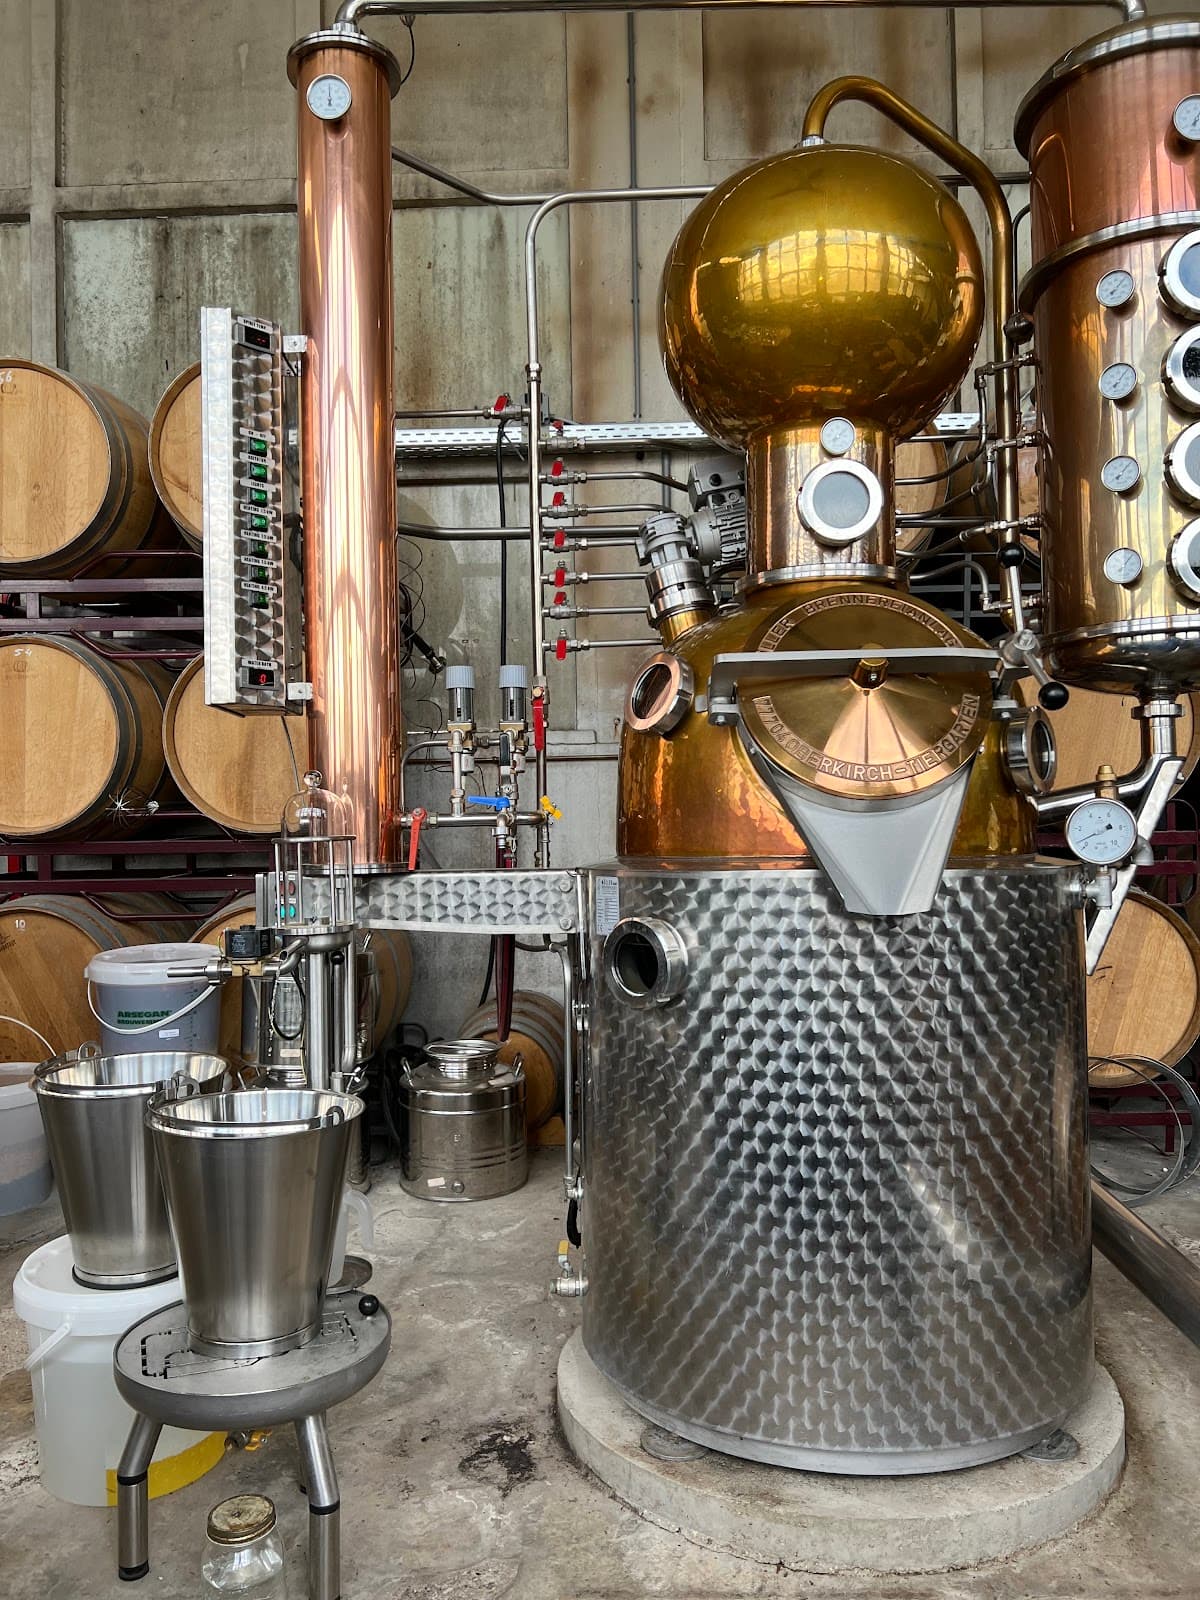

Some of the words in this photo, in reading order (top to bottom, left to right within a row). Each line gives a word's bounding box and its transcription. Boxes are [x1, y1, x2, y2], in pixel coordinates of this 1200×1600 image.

[758, 618, 796, 651] LLER
[803, 593, 963, 648] BRENNEREIANLAG
[754, 697, 789, 743] 77704
[784, 694, 979, 781] OBERKIRCH-TIERGARTEN
[15, 919, 26, 929] 10
[117, 1010, 170, 1018] ARSEGAN
